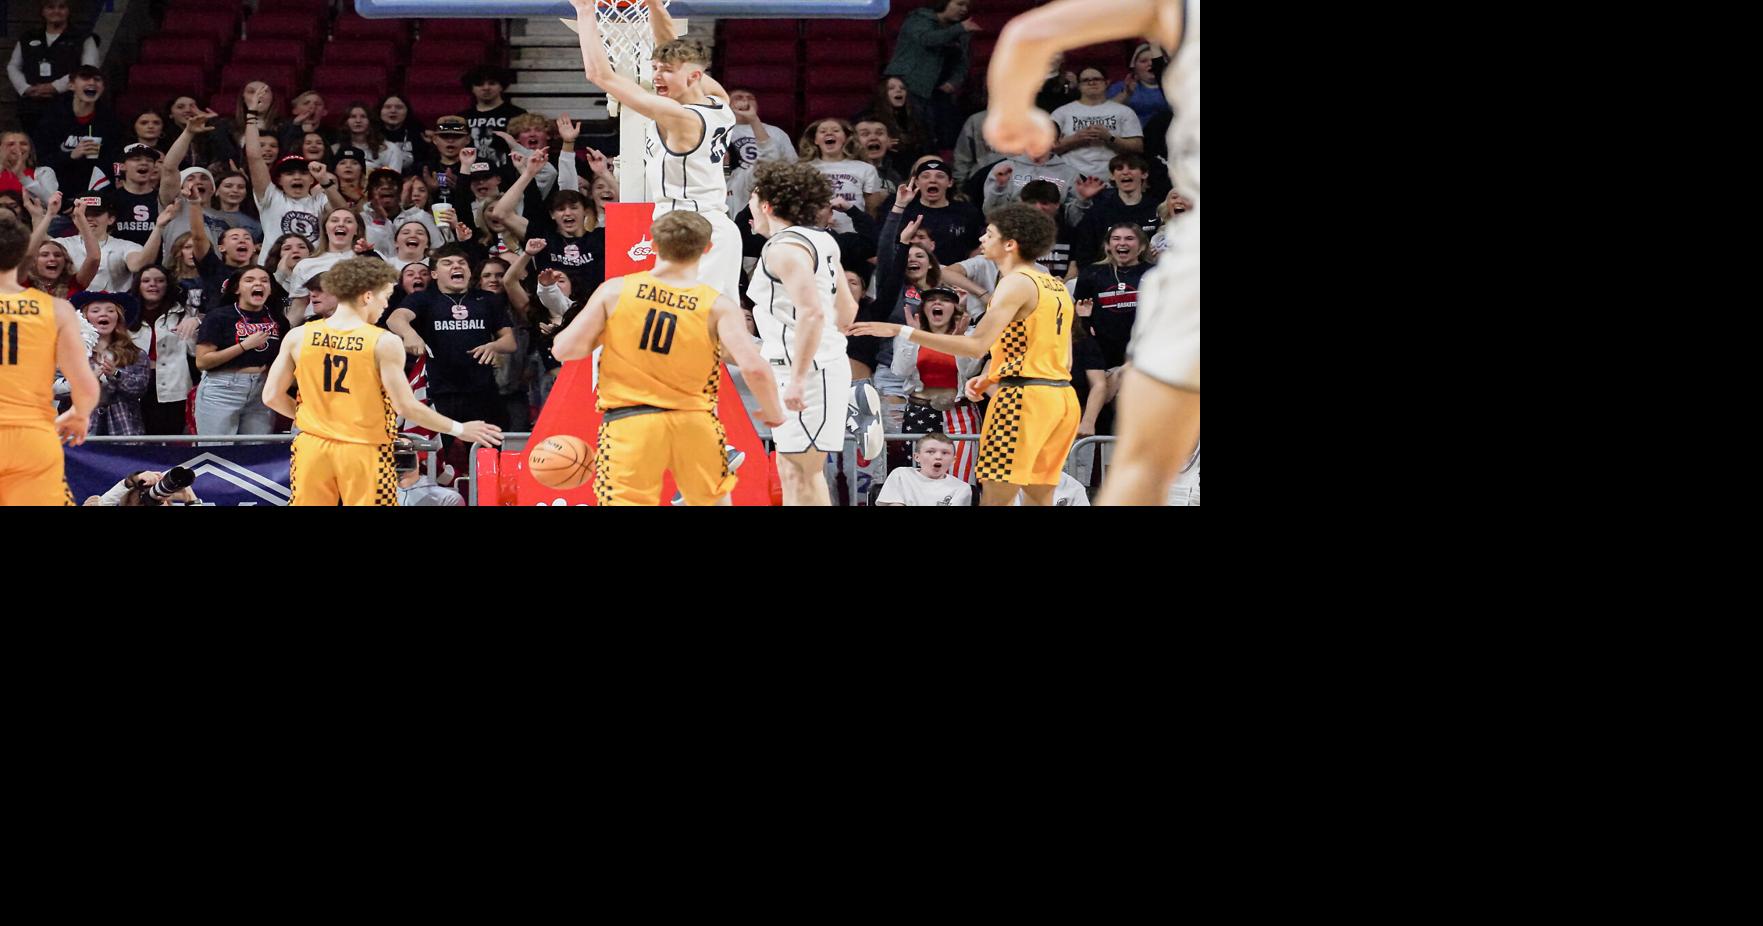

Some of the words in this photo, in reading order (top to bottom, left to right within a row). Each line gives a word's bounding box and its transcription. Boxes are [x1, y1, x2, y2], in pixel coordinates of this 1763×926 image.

[1072, 115, 1117, 128] PATRIOTS
[133, 204, 150, 222] S
[564, 244, 580, 260] S
[1117, 282, 1126, 291] S
[636, 283, 699, 311] EAGLES
[451, 304, 469, 321] S
[434, 319, 486, 331] BASEBALL
[639, 307, 678, 355] 10
[312, 331, 364, 351] EAGLES
[323, 353, 350, 394] 12
